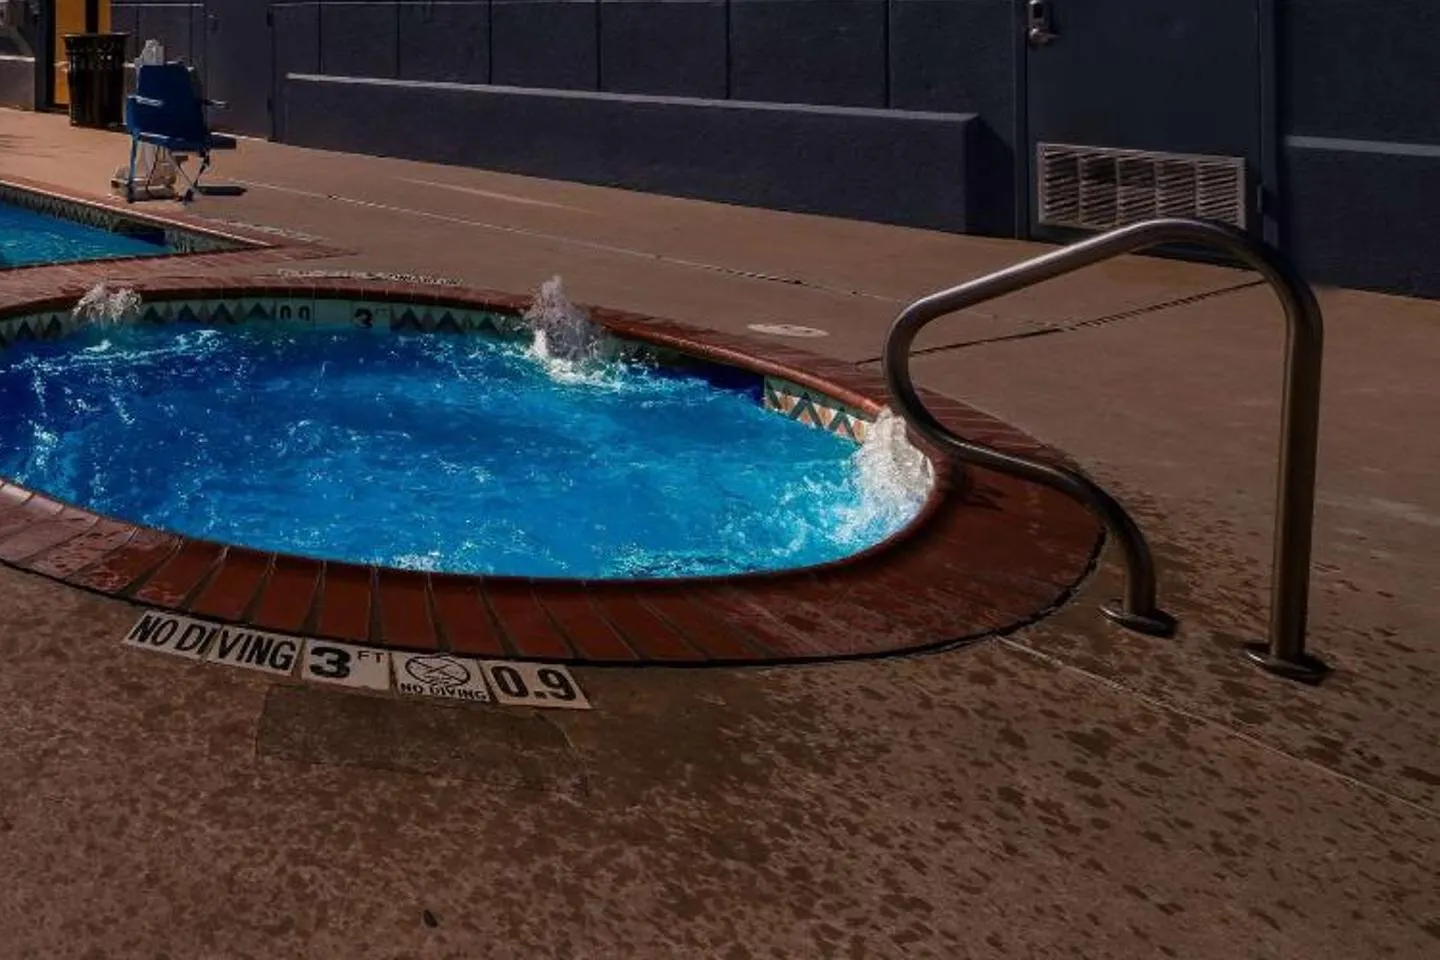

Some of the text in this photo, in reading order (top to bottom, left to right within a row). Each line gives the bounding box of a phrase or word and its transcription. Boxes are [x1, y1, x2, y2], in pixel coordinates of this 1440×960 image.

[129, 615, 297, 670] NO DIVING
[310, 646, 351, 678] 3
[400, 682, 423, 694] NO
[491, 666, 577, 701] 0.9
